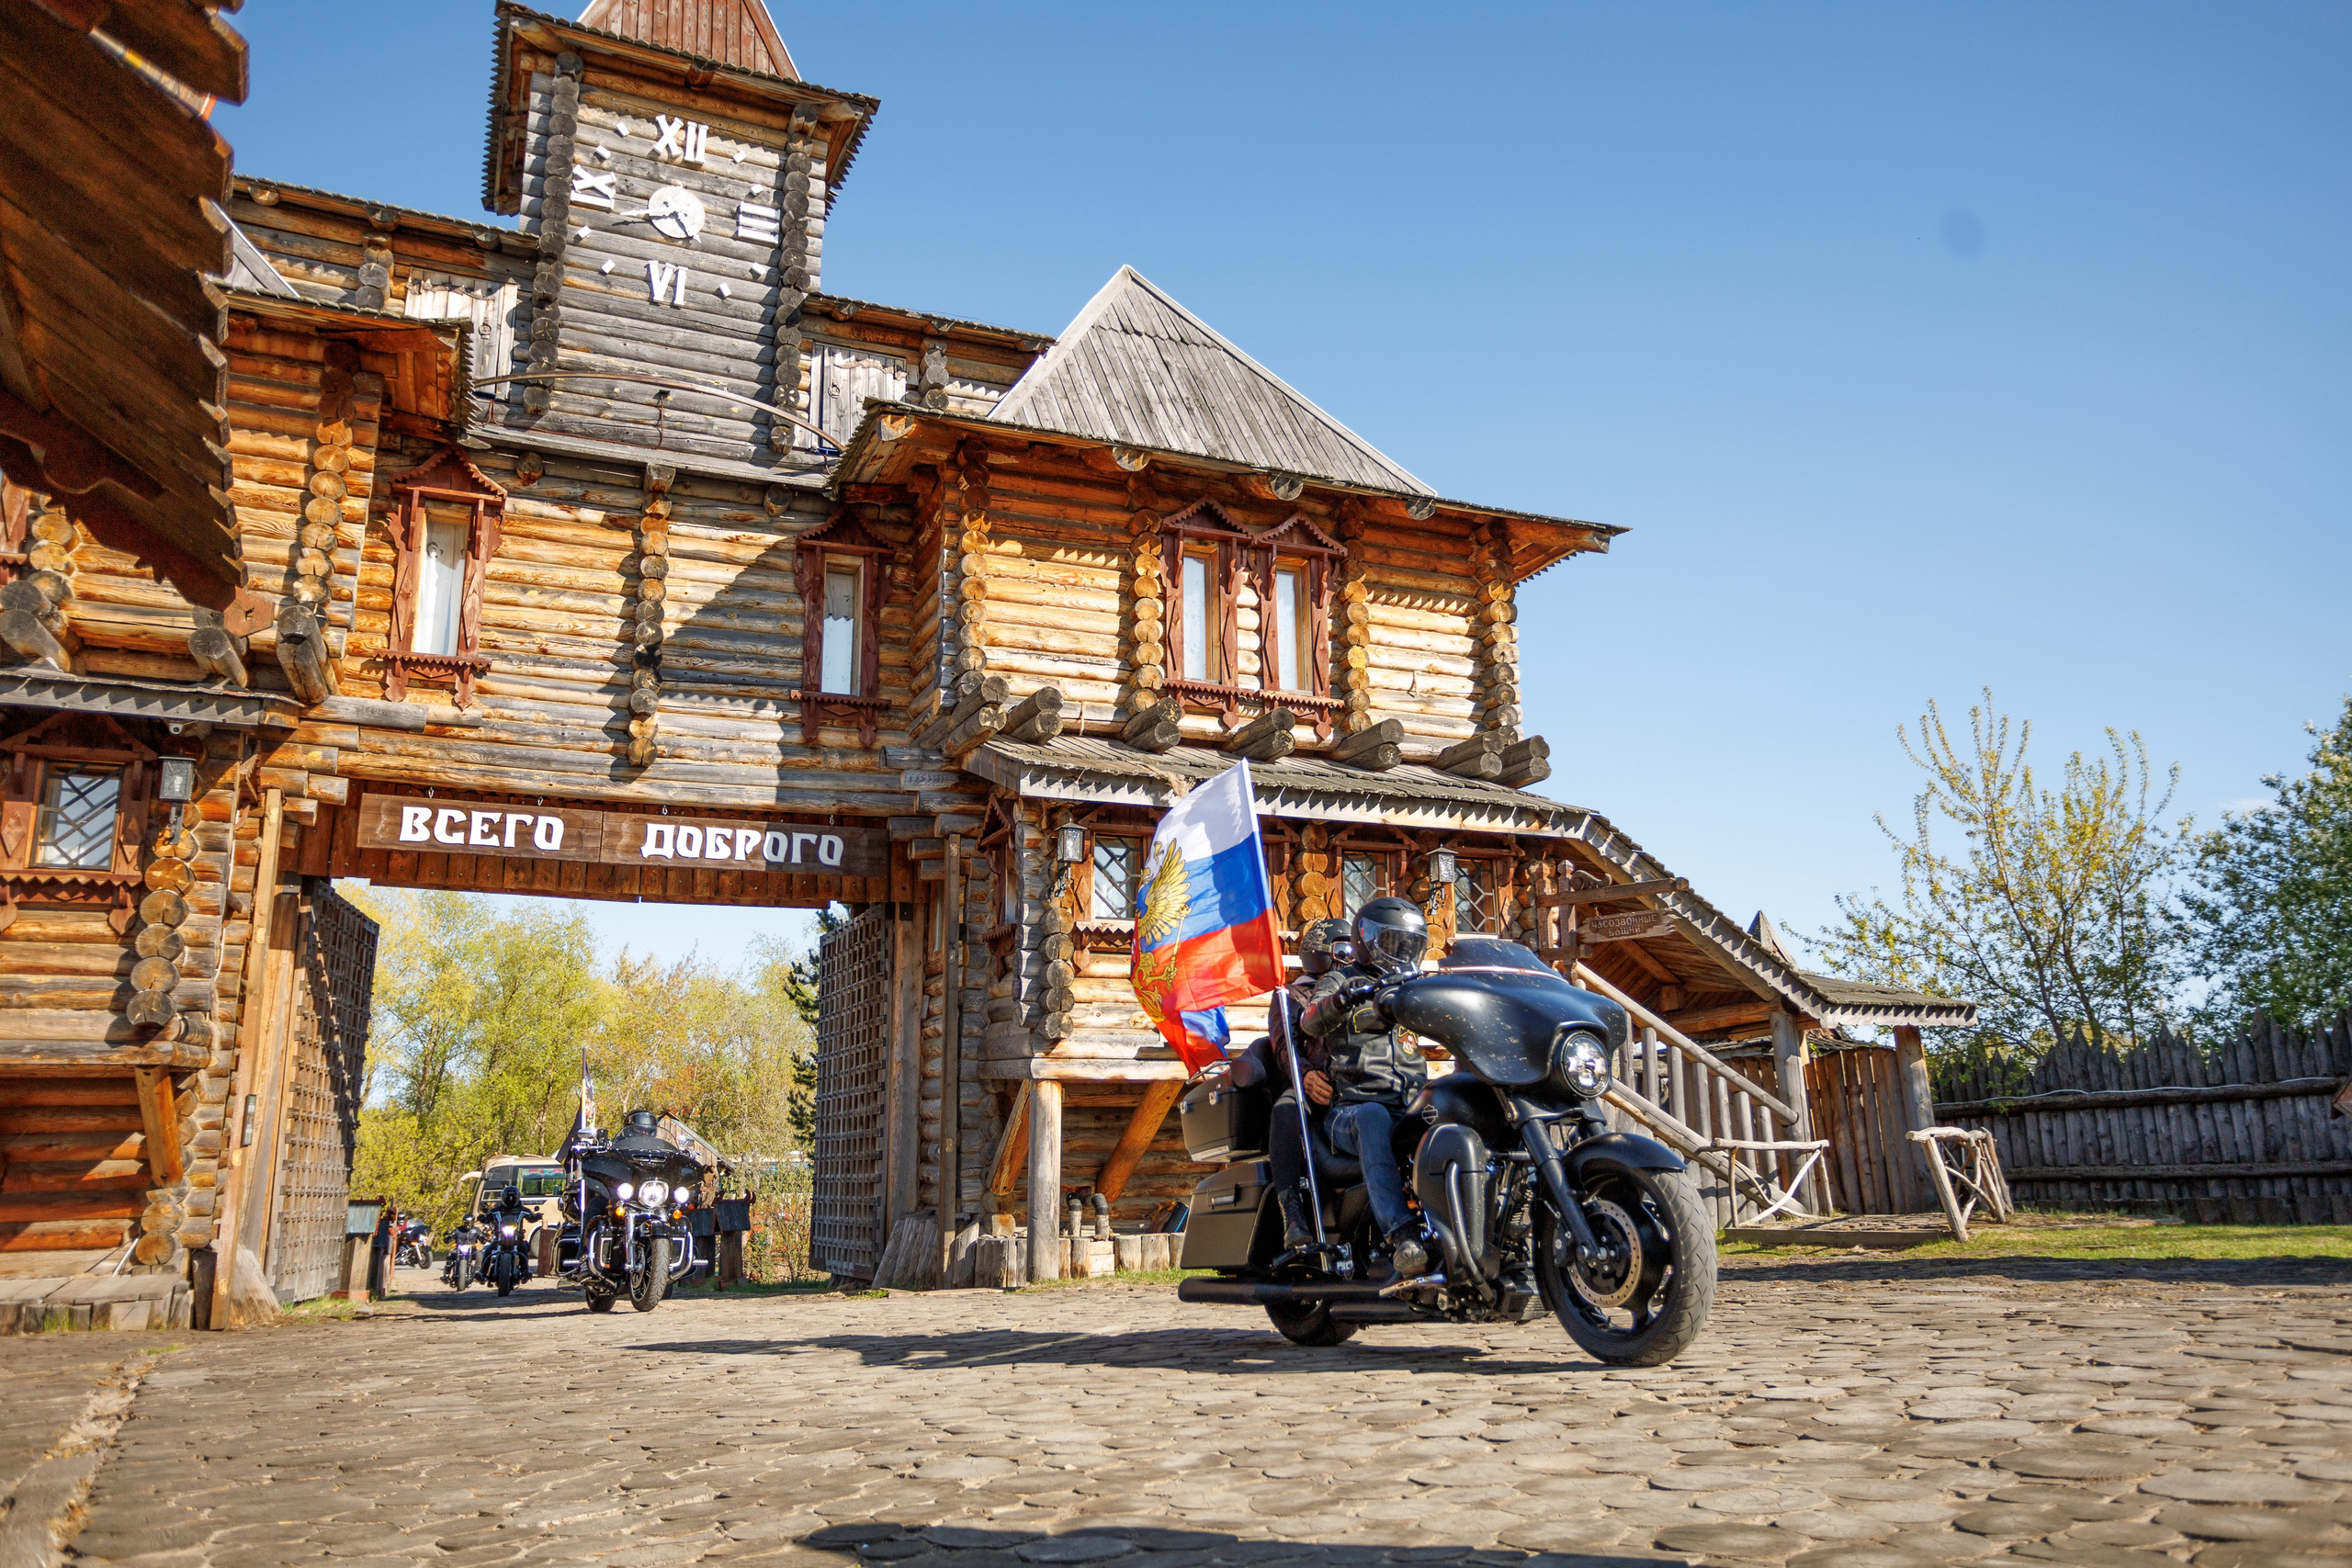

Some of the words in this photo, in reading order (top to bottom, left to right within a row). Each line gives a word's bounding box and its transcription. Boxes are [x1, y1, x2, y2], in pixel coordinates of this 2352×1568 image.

[653, 114, 709, 165] XII
[736, 200, 781, 245] III
[647, 259, 689, 307] VI
[398, 805, 565, 852] ВСЕГО
[639, 822, 845, 866] ДОБРОГО
[1591, 914, 1657, 930] ЧАСОЗВОННЫЕ
[1608, 924, 1641, 937] БАШНИ
